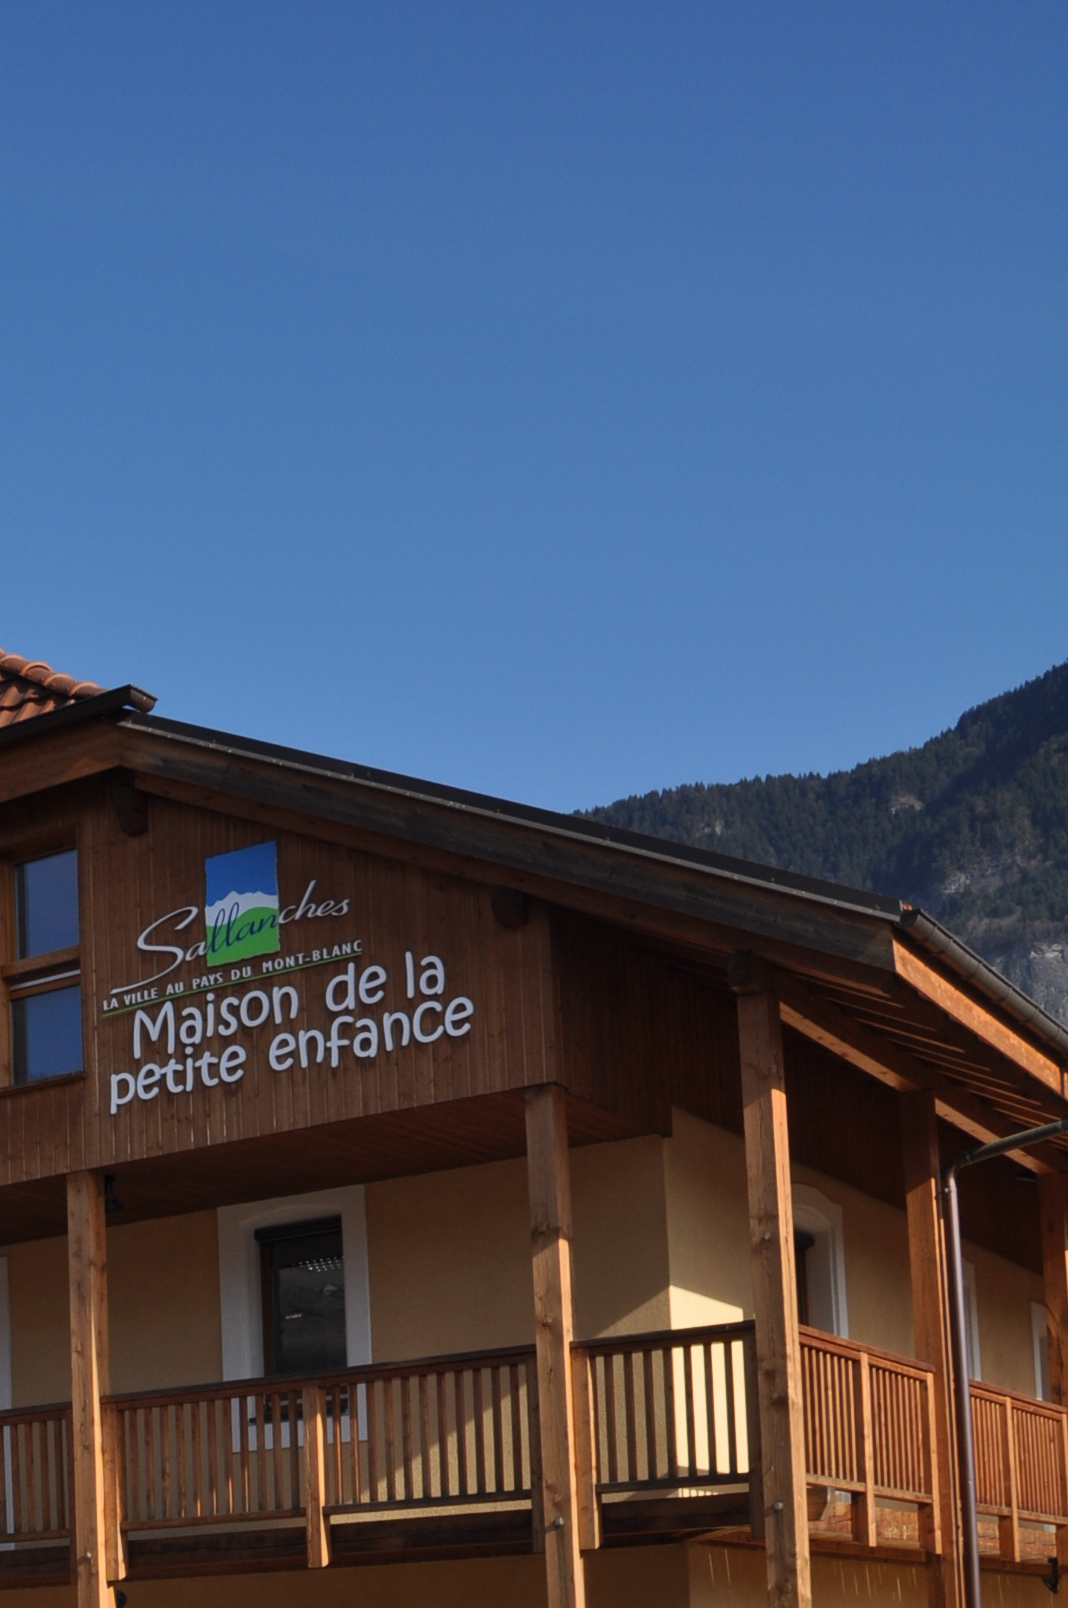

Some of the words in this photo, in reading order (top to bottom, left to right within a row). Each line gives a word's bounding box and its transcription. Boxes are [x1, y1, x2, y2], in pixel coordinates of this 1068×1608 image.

[102, 999, 119, 1011] LA
[124, 987, 159, 1005] VILLE
[165, 981, 184, 995] AU
[192, 973, 224, 990] PAYS
[231, 966, 252, 980] DU
[262, 939, 363, 973] MONT-BLANC
[110, 879, 350, 994] Sallanches
[110, 1046, 247, 1115] petite
[269, 996, 475, 1071] enfance
[133, 984, 299, 1060] Maison
[325, 962, 388, 1012] de
[405, 951, 446, 999] la
